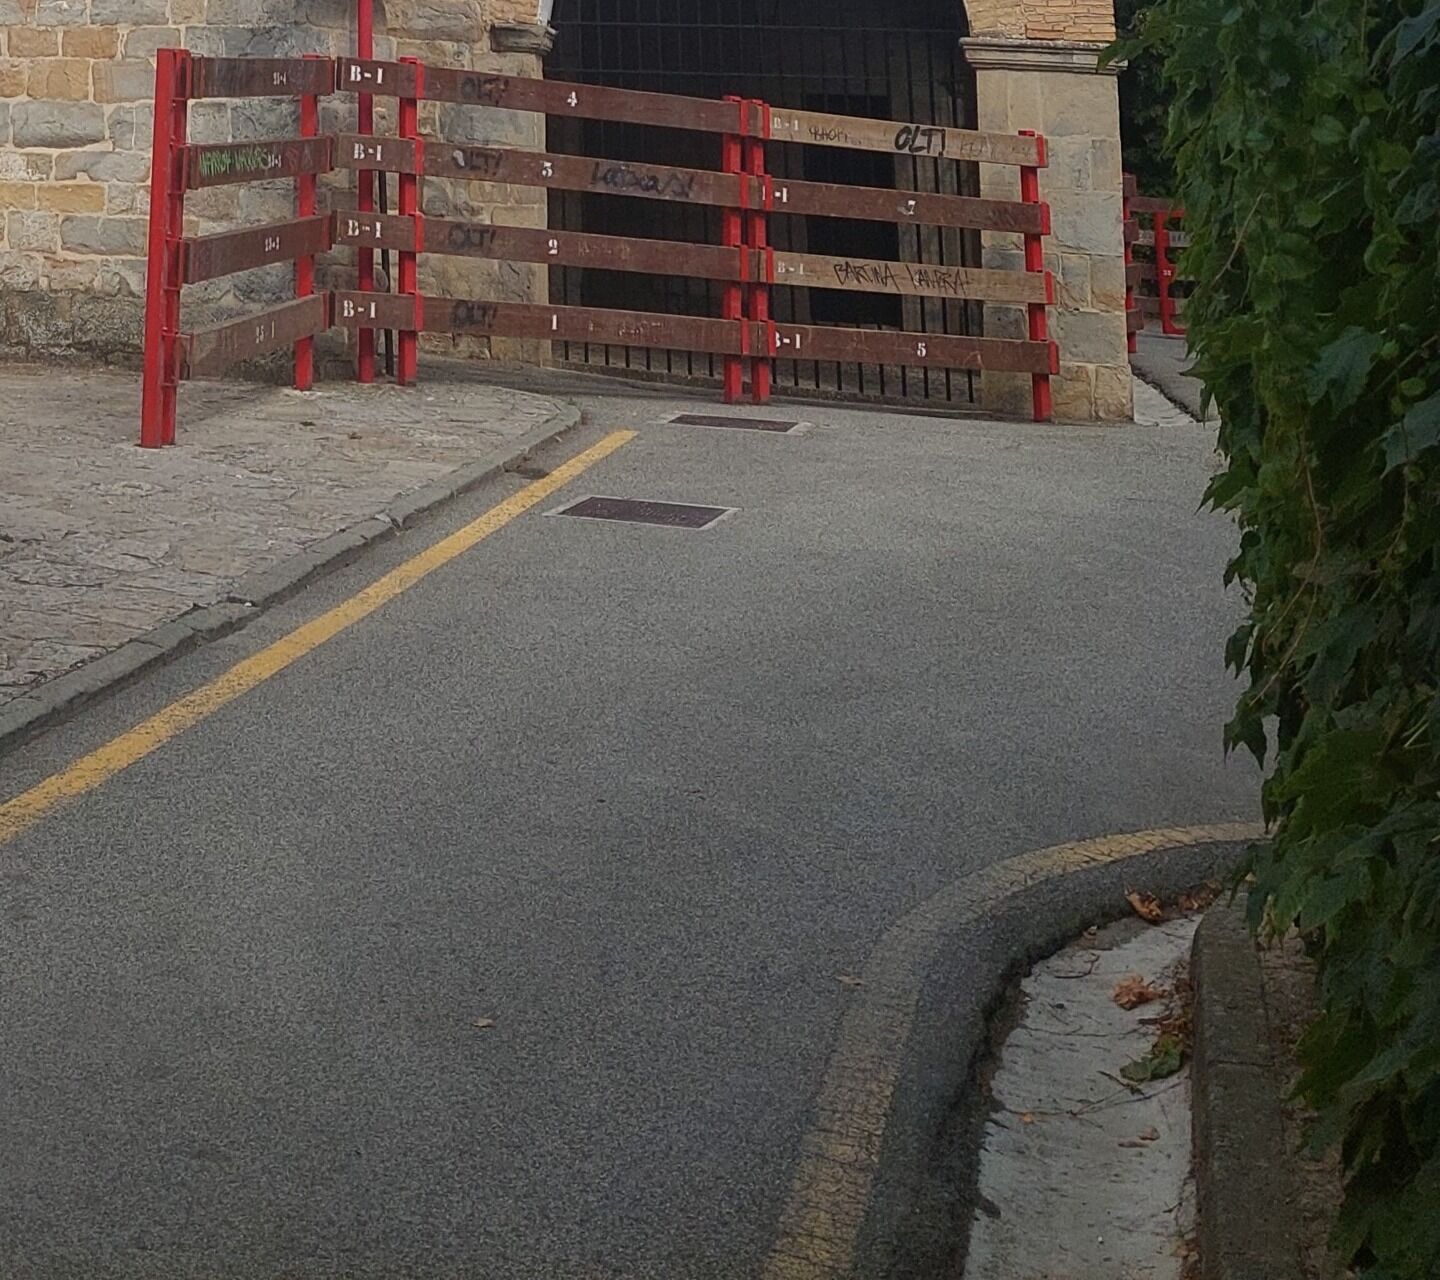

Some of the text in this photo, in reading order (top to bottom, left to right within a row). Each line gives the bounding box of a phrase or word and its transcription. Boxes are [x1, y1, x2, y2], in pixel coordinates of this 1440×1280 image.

[567, 91, 578, 108] 4
[893, 124, 947, 159] OLT!
[548, 238, 559, 255] 2
[916, 342, 927, 358] 5
